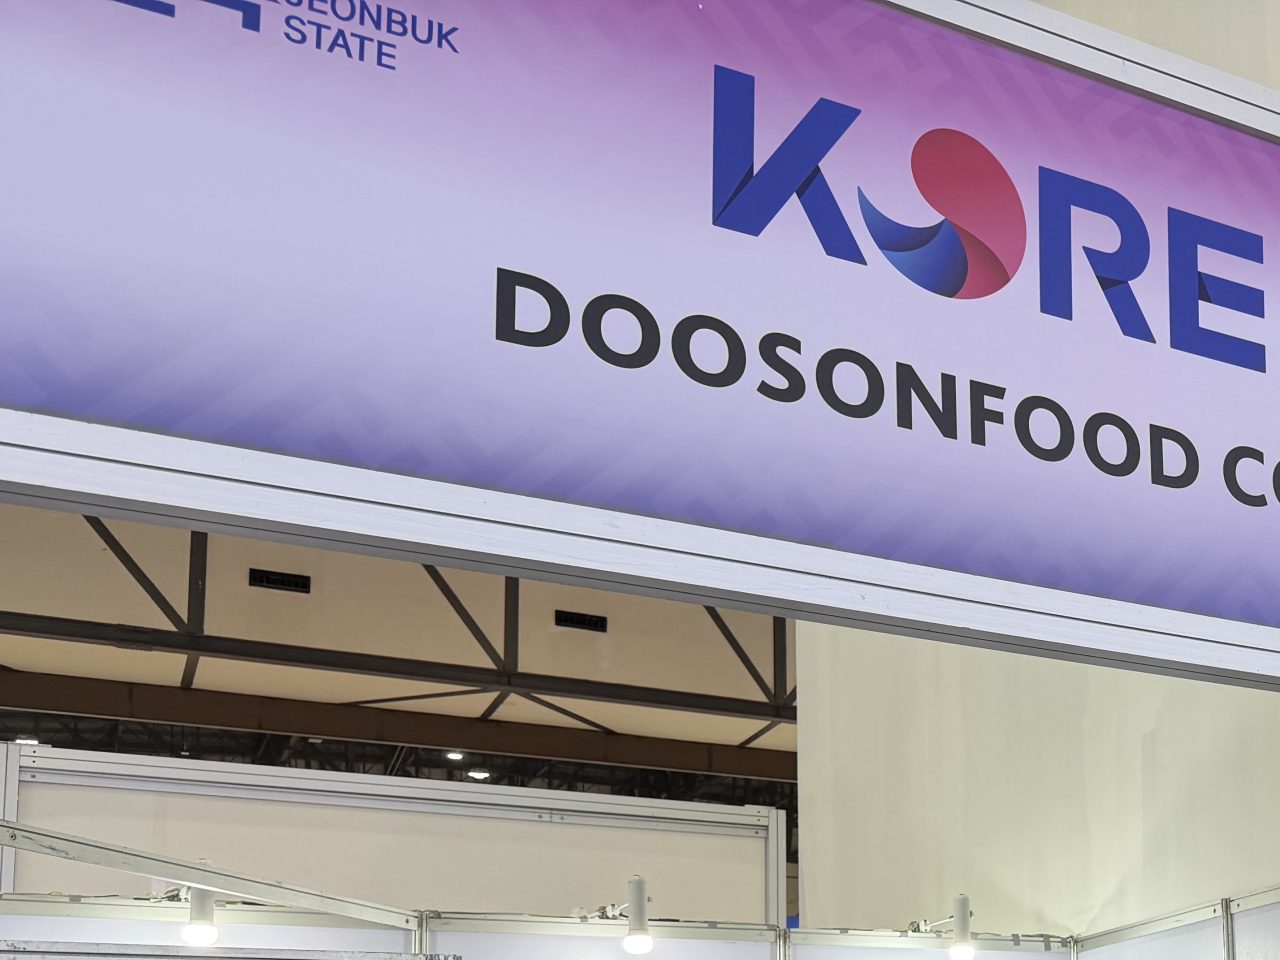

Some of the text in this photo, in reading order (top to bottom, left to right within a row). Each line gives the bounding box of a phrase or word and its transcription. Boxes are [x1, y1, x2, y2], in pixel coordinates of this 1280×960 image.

[280, 0, 460, 53] EONBUK
[283, 15, 397, 71] STATE
[495, 266, 1201, 489] DOOSONFOOD
